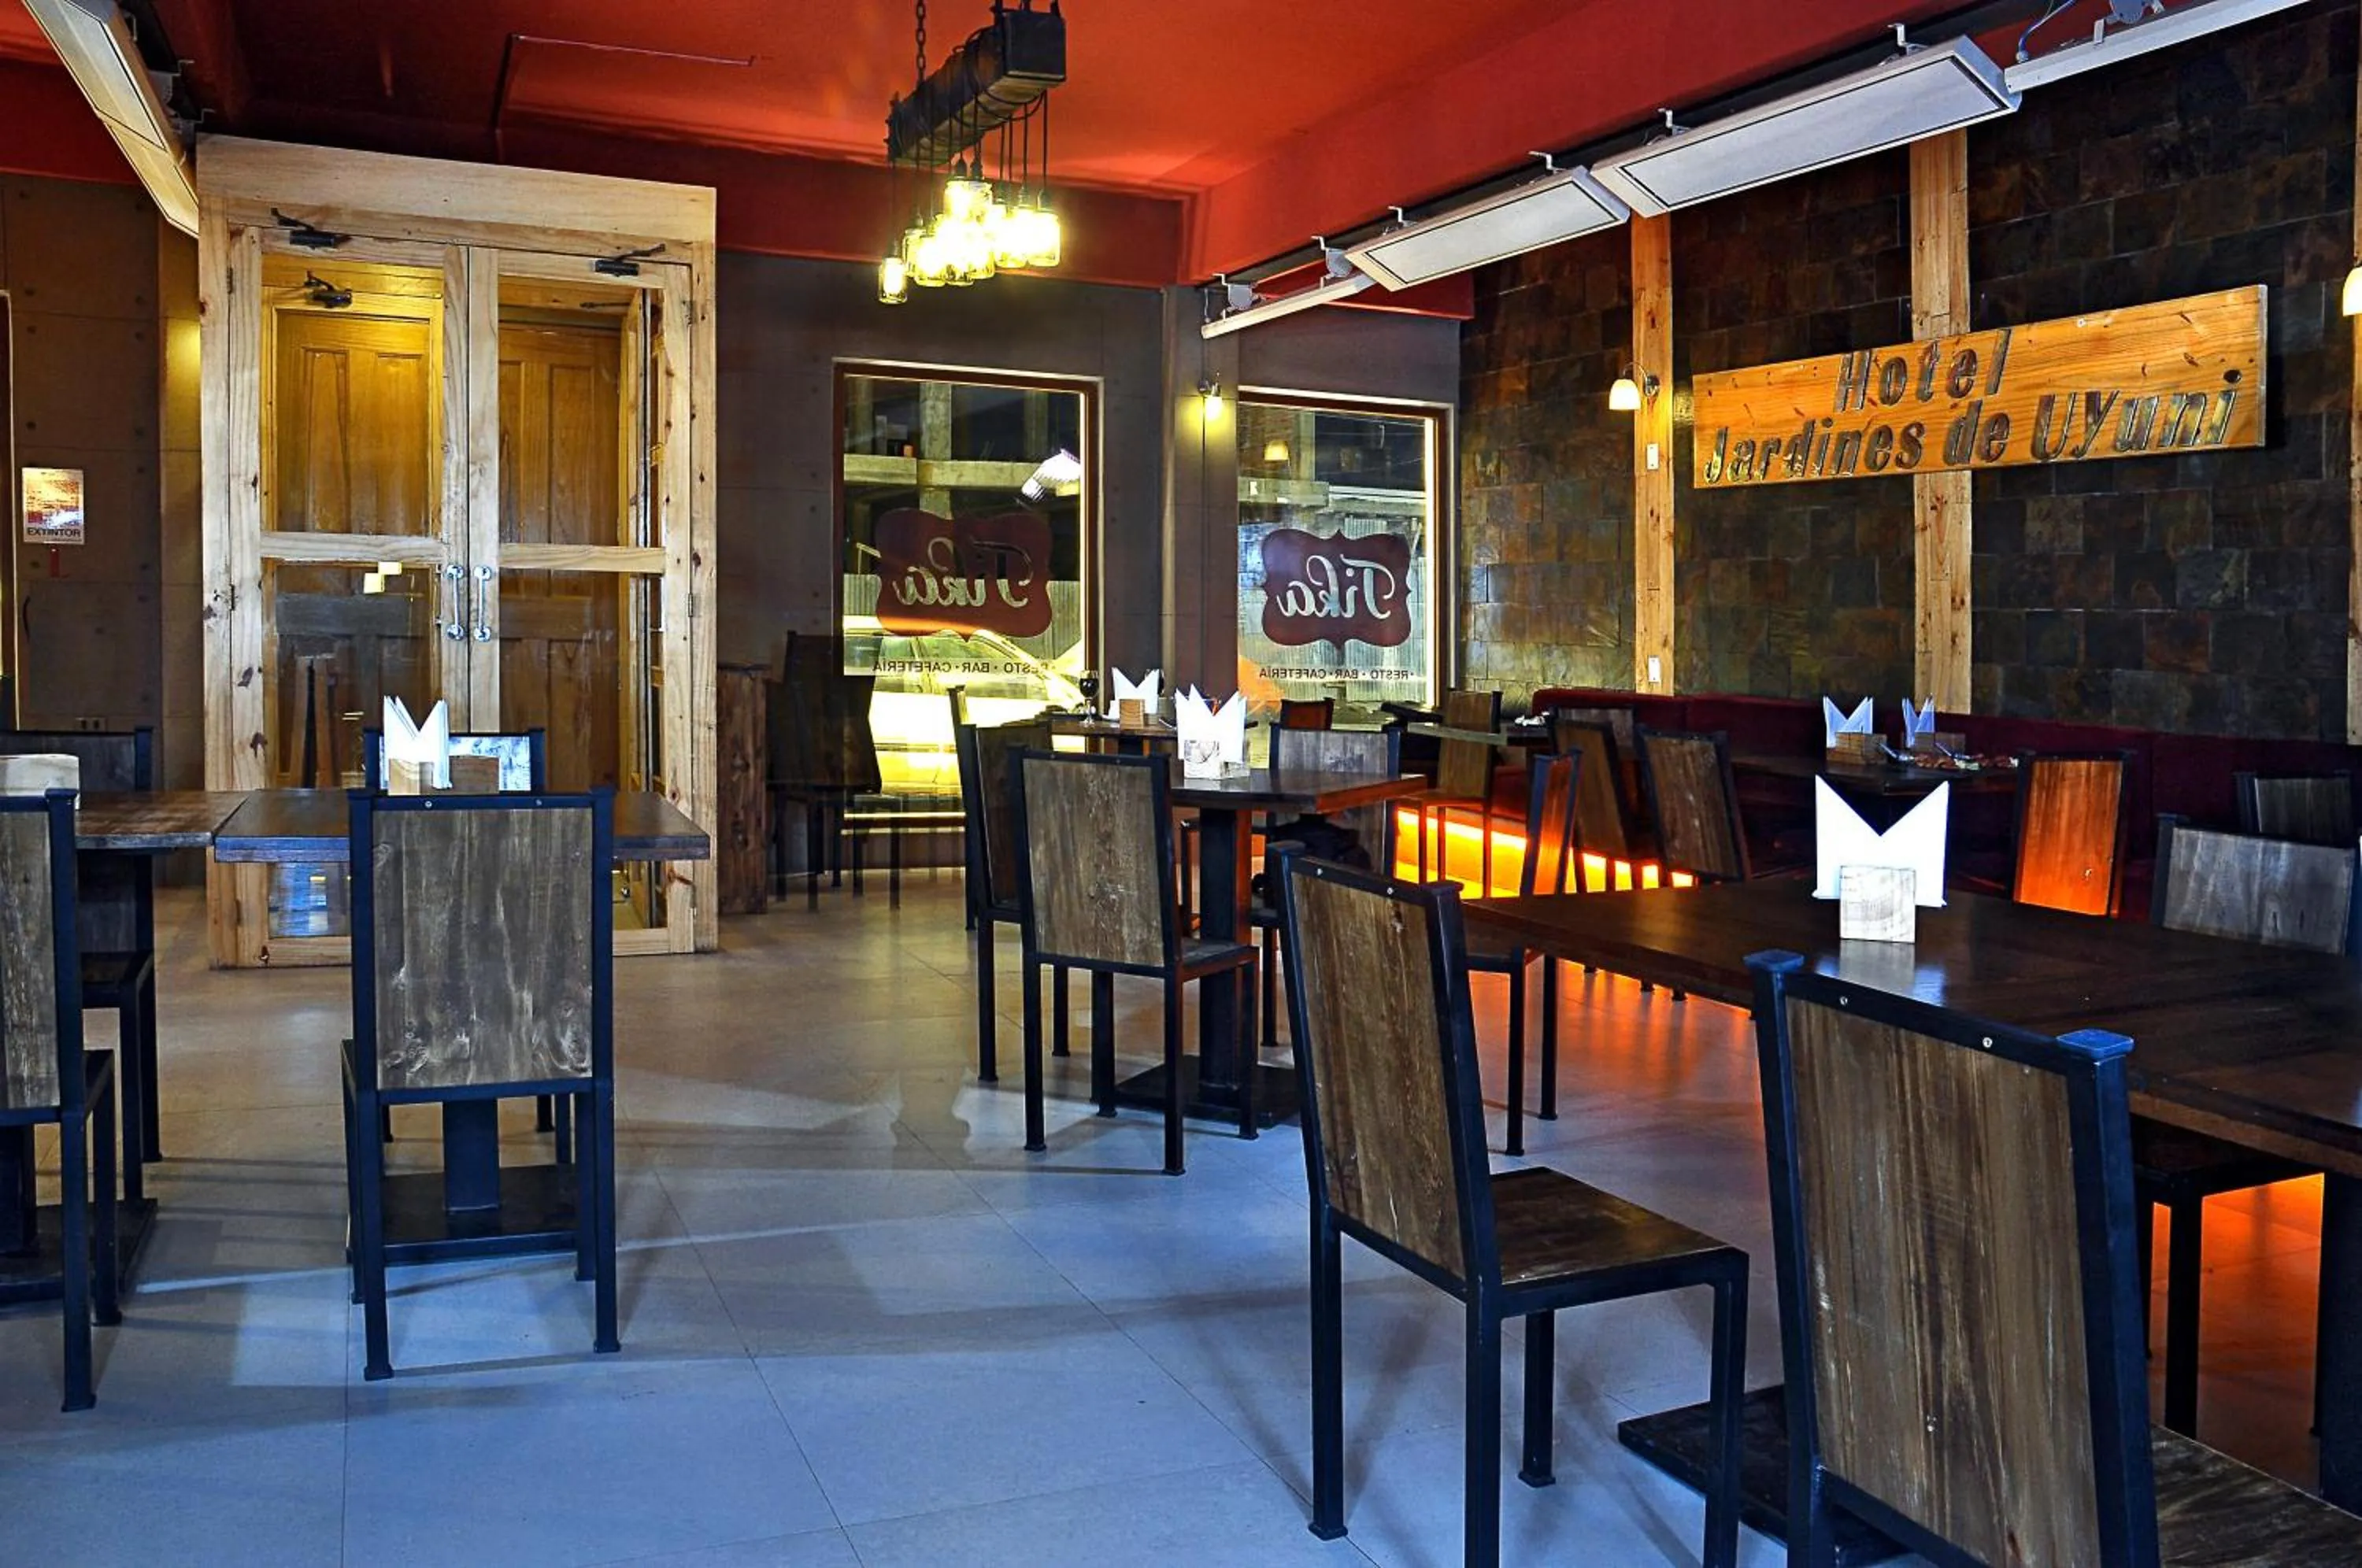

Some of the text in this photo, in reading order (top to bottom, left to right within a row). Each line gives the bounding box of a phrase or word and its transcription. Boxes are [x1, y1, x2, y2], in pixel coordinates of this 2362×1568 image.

[1835, 328, 2012, 413] Hotel
[1703, 369, 2242, 484] Jardines de Uyuni
[27, 527, 81, 537] EXTINTOR
